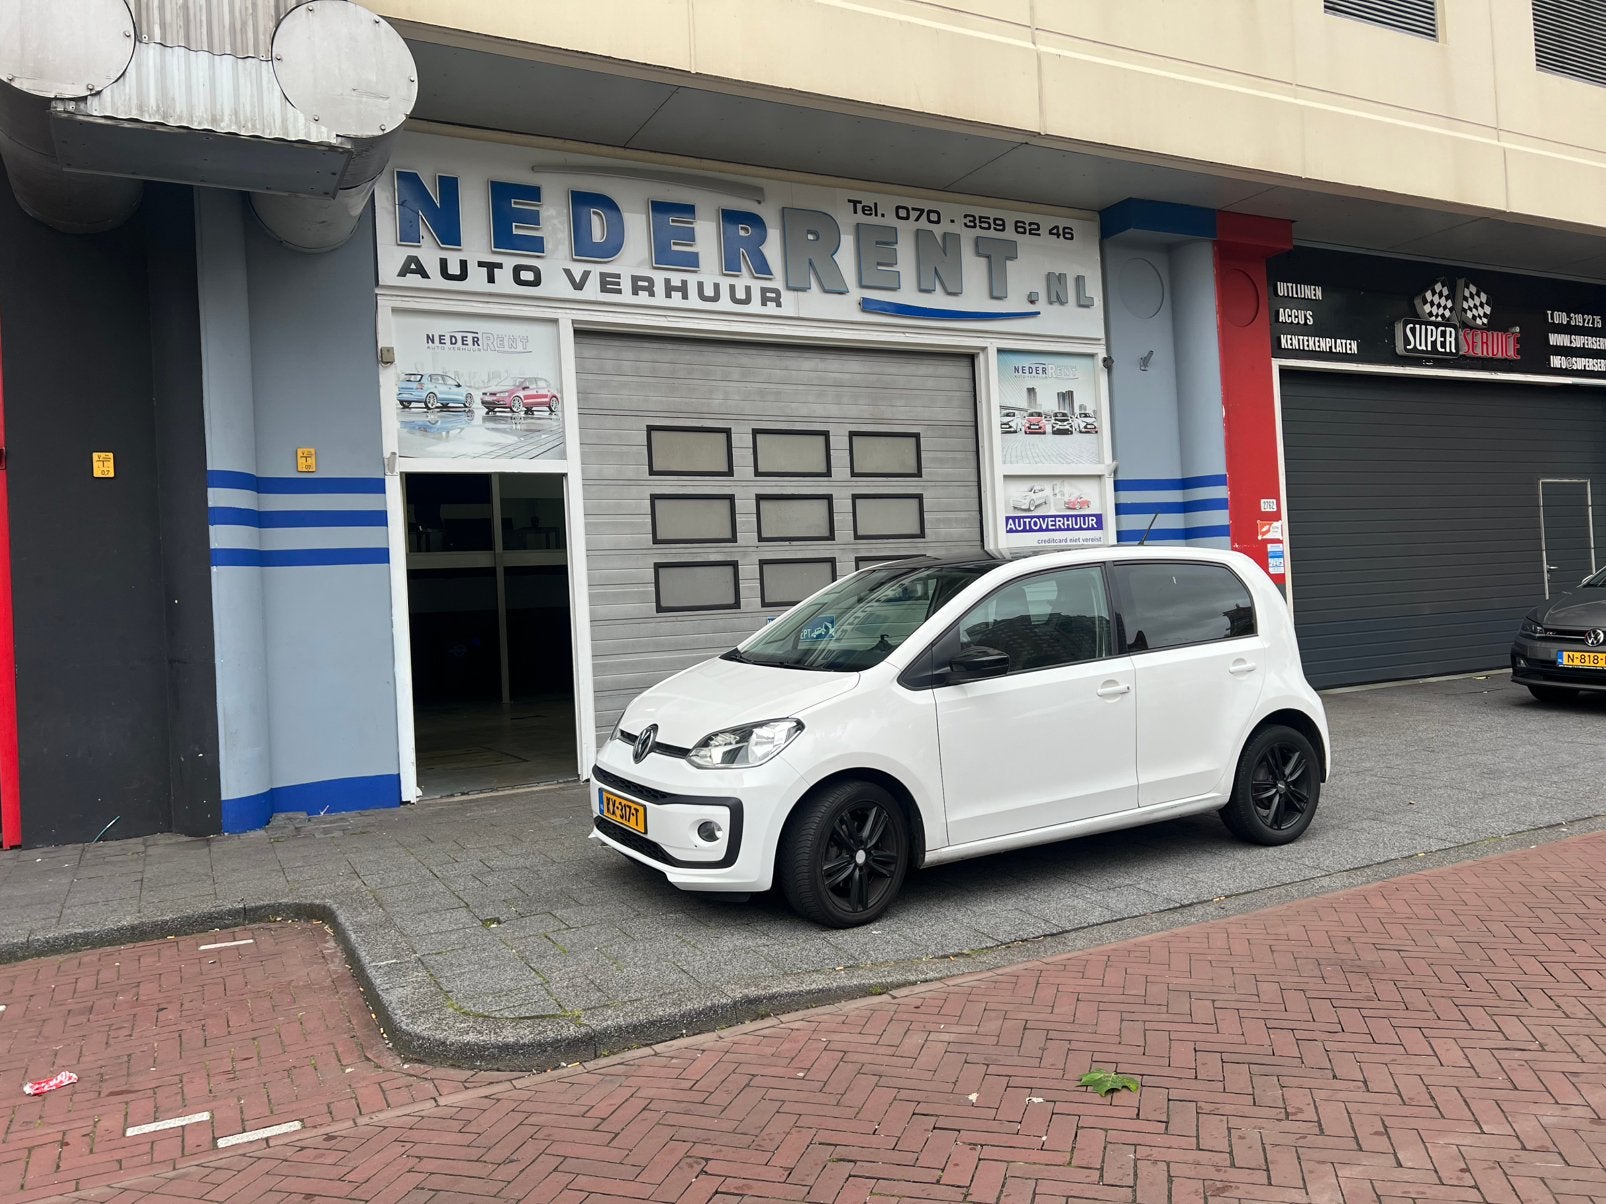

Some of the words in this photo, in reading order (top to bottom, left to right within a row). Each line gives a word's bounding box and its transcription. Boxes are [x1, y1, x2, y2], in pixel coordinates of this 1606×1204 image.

[848, 198, 885, 218] Tel.
[895, 204, 942, 225] 070
[963, 213, 1006, 232] 359
[1014, 219, 1041, 237] 62
[1048, 224, 1074, 241] 46
[397, 254, 542, 287] AUTO
[562, 267, 782, 308] VERHUUR
[1277, 281, 1322, 300] UITLIJNEN
[1279, 308, 1314, 325] ACCU'S
[1584, 314, 1593, 327] 22
[1280, 334, 1358, 354] KENTEKENPLATEN
[1405, 323, 1456, 353] SUPER
[1462, 328, 1520, 359] SERVICE
[1006, 516, 1097, 531] AUTOVERHUUR
[1567, 653, 1606, 666] N-818-
